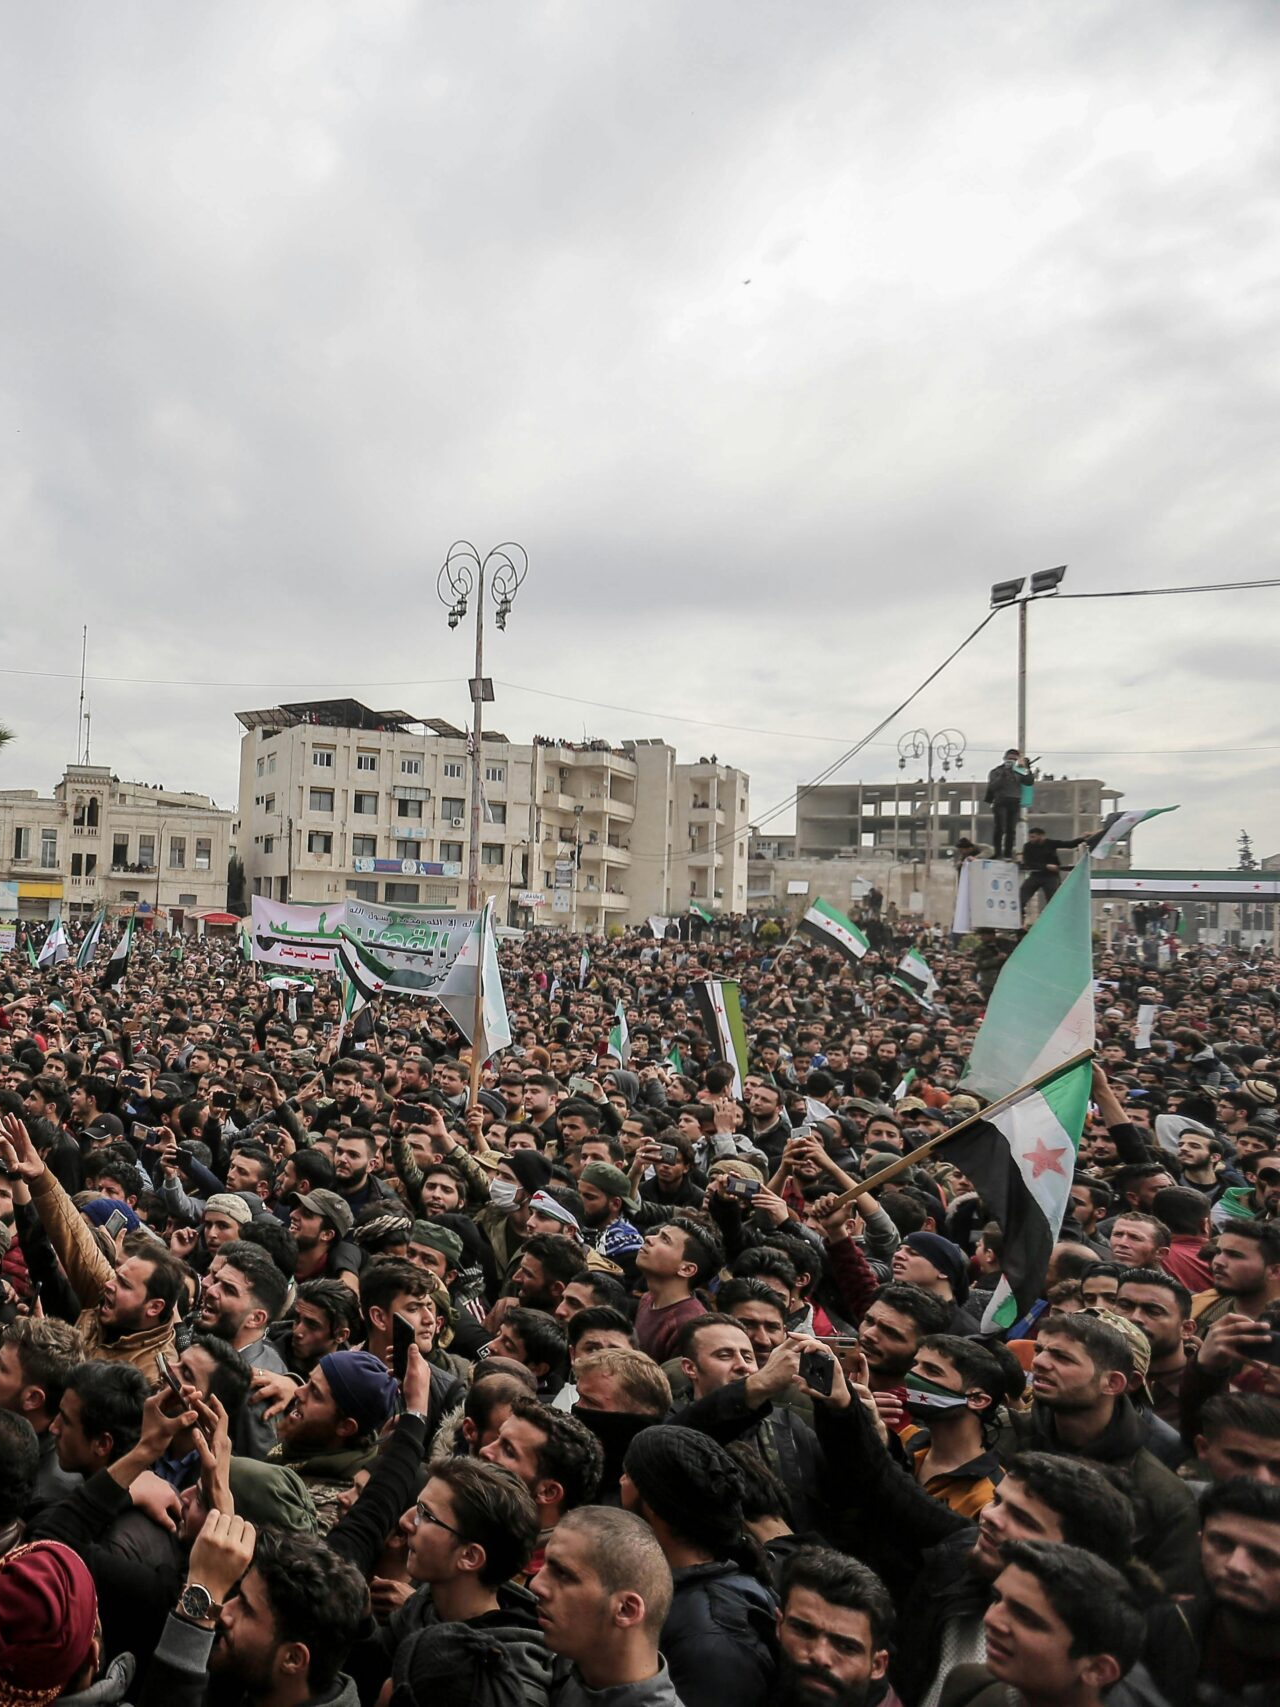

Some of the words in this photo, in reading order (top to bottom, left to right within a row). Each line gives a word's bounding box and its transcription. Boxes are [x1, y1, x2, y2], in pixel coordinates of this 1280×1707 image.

[349, 907, 365, 915] الله
[279, 947, 308, 959] نركع
[310, 951, 331, 961] لن
